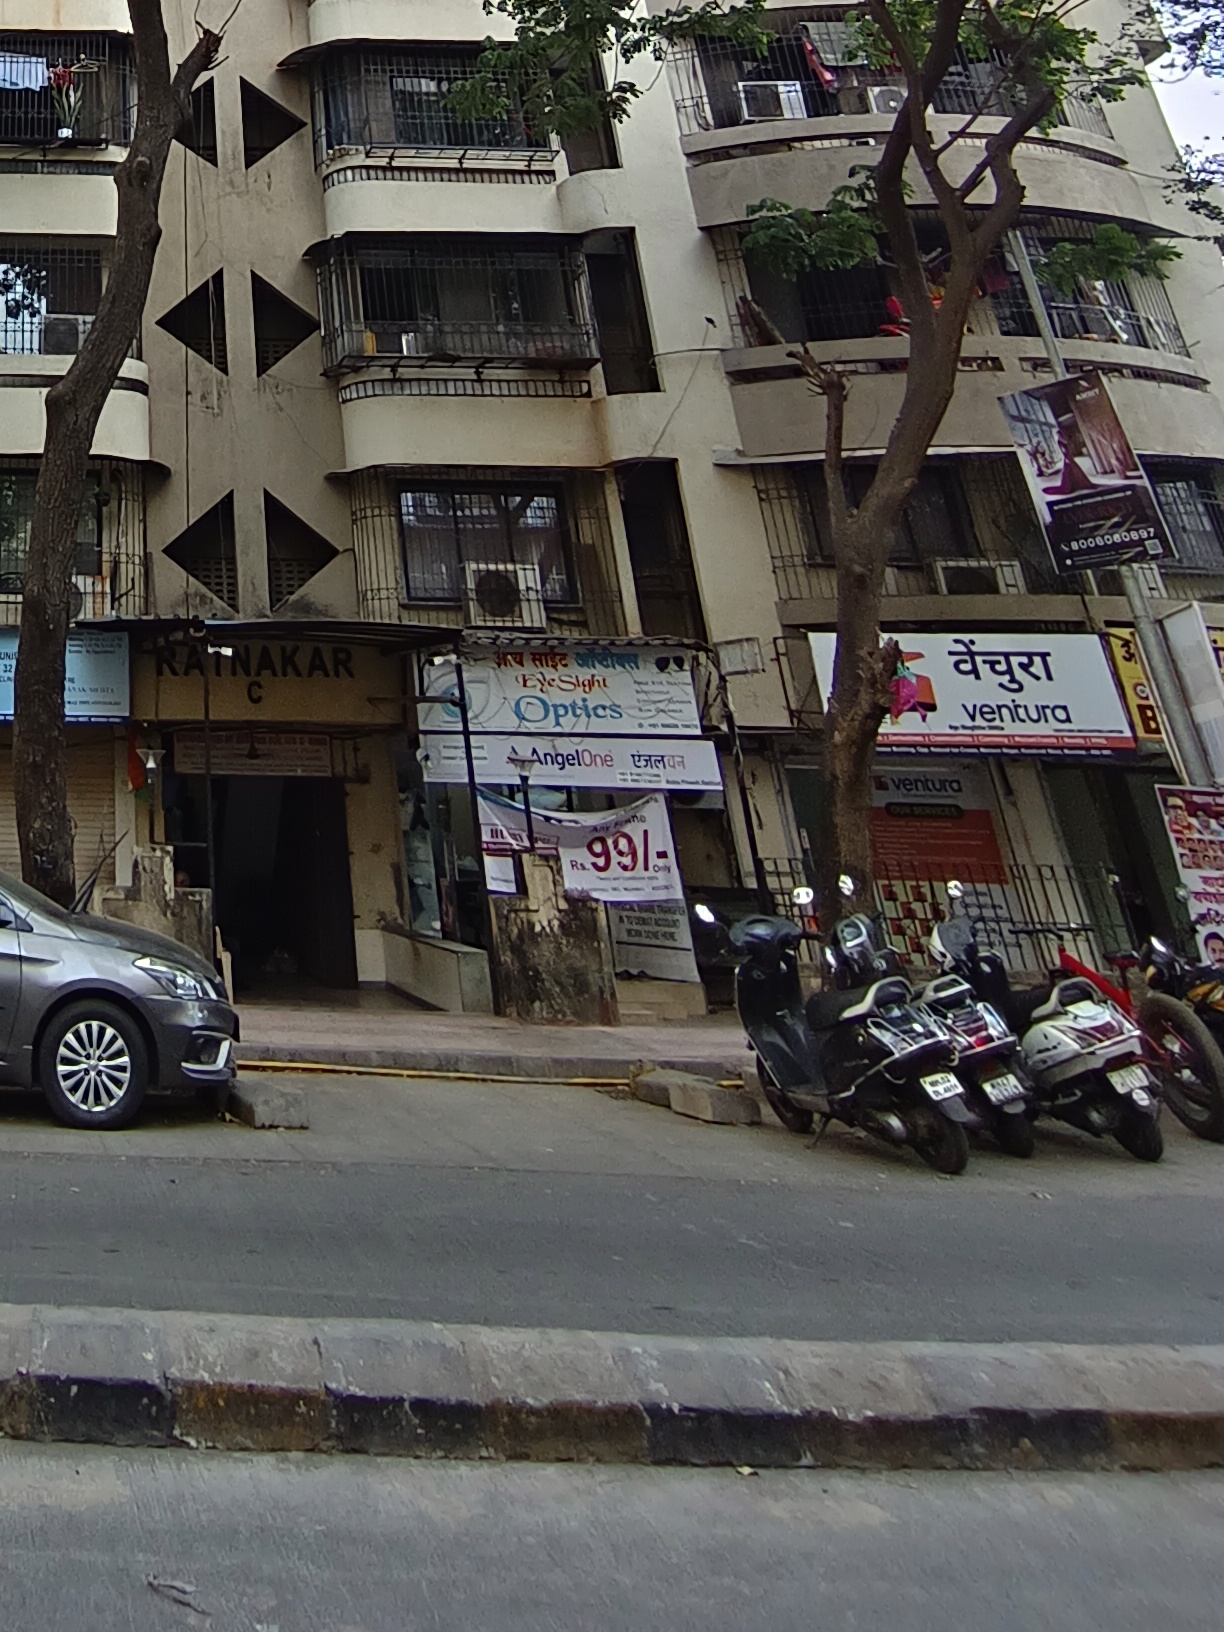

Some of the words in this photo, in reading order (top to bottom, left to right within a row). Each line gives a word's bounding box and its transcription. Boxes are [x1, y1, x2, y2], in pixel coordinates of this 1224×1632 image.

[3, 663, 13, 673] 32
[156, 643, 355, 679] RATNAKAR
[948, 638, 1054, 693] वेंचुरा
[246, 680, 263, 704] C
[515, 671, 608, 694] EyeSight
[514, 695, 623, 727] Optics
[962, 699, 1073, 724] ventura
[891, 775, 963, 793] ventura
